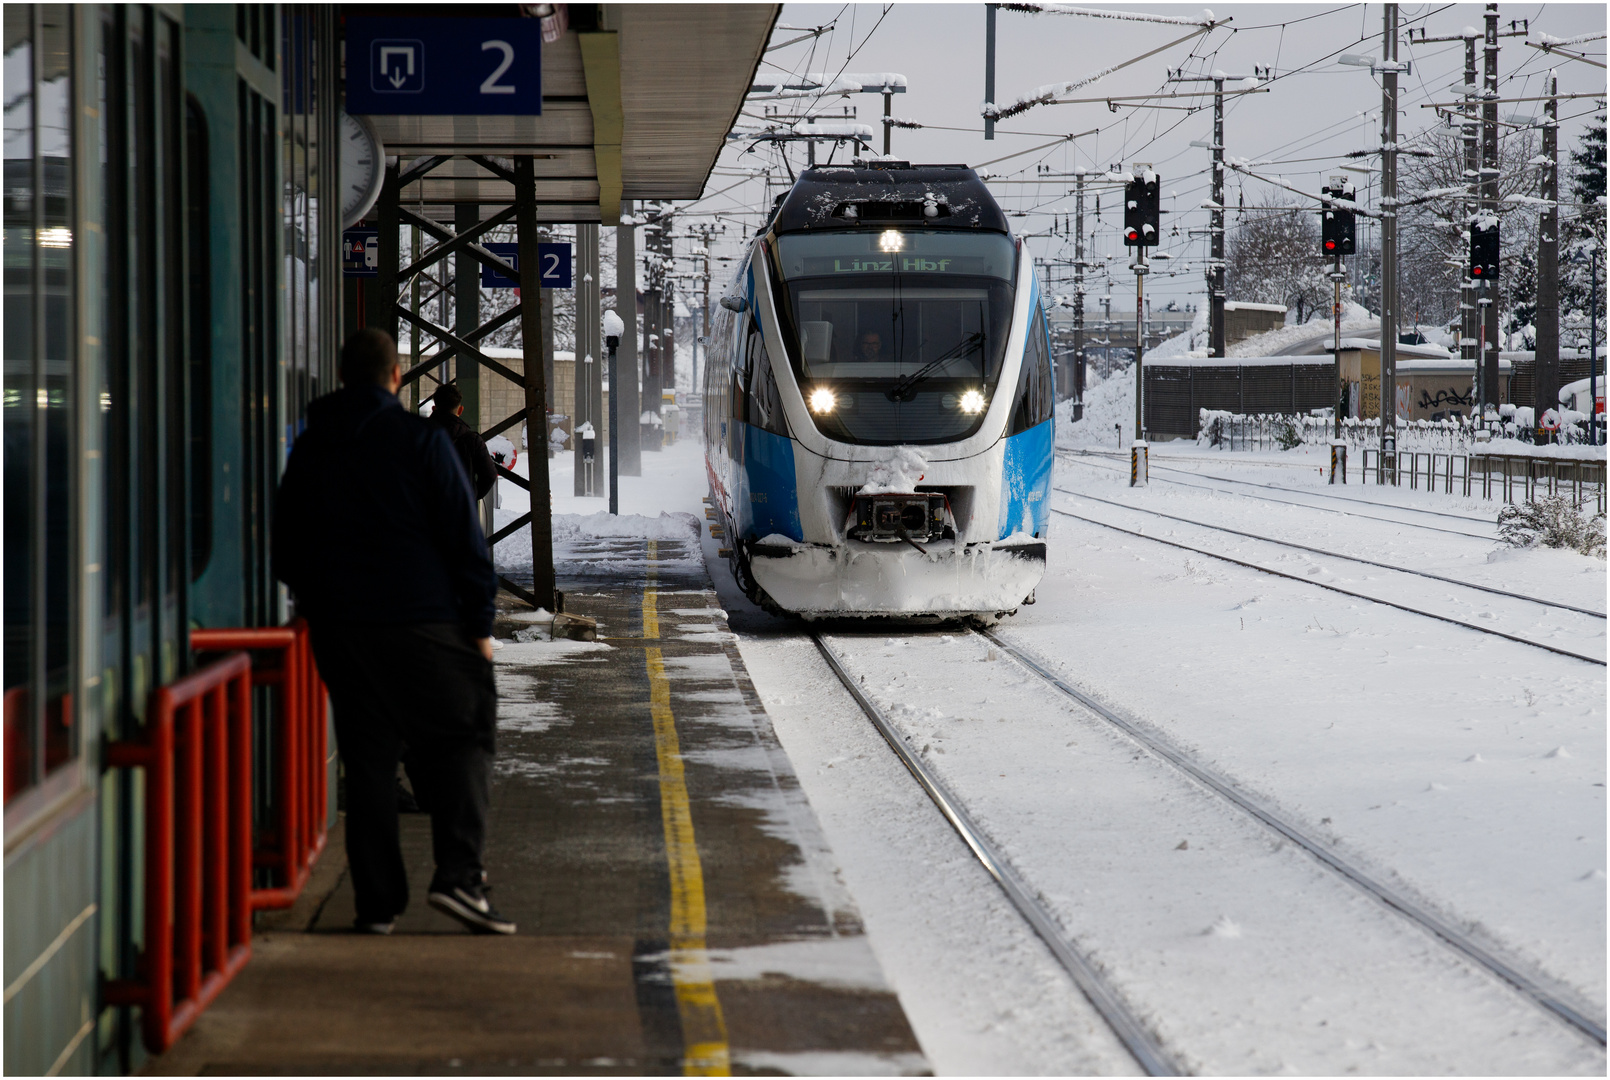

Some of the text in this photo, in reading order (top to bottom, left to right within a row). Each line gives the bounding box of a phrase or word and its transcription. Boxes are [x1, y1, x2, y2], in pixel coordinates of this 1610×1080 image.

[479, 40, 516, 94] 2
[542, 253, 560, 279] 2
[834, 258, 952, 272] Linz Hbf
